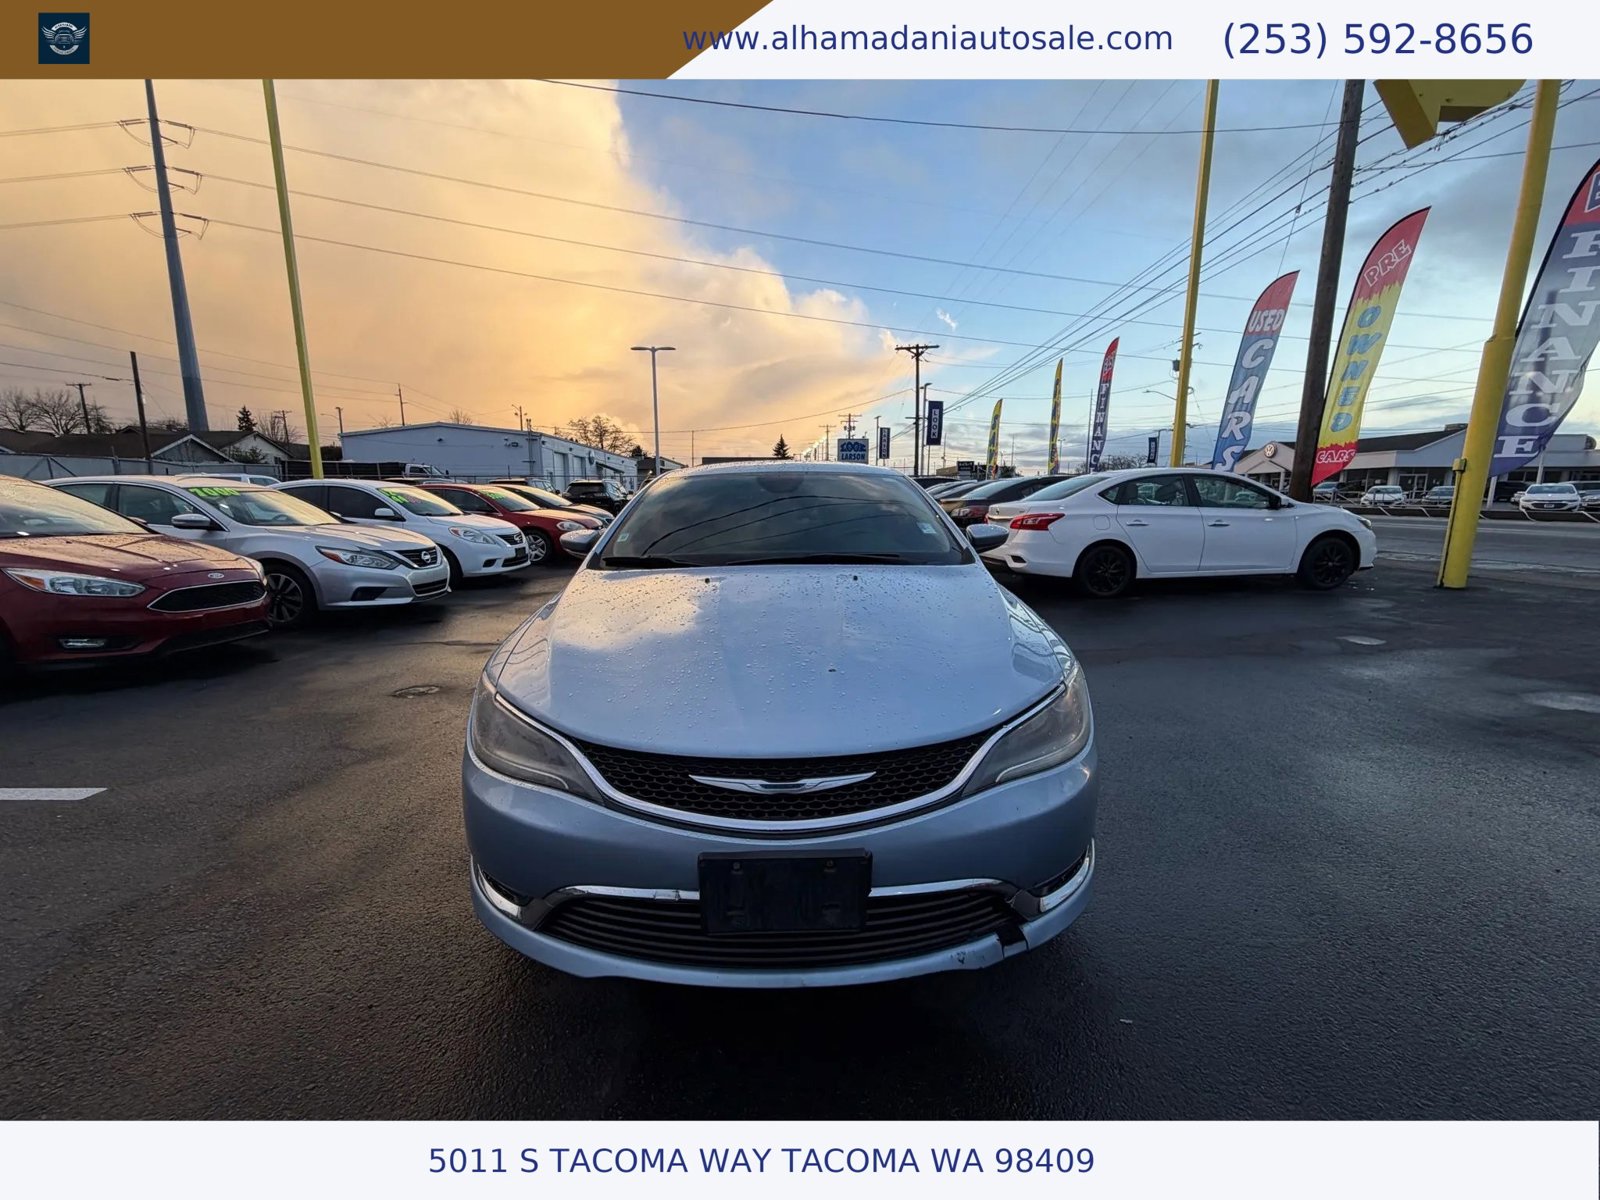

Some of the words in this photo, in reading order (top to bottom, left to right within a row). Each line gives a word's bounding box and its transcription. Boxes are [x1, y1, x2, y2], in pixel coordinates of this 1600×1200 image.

[1364, 239, 1412, 287] PRE
[1248, 308, 1286, 333] USED
[1330, 305, 1382, 433] OWNED
[1214, 338, 1274, 472] CARS
[1316, 449, 1357, 464] CARS
